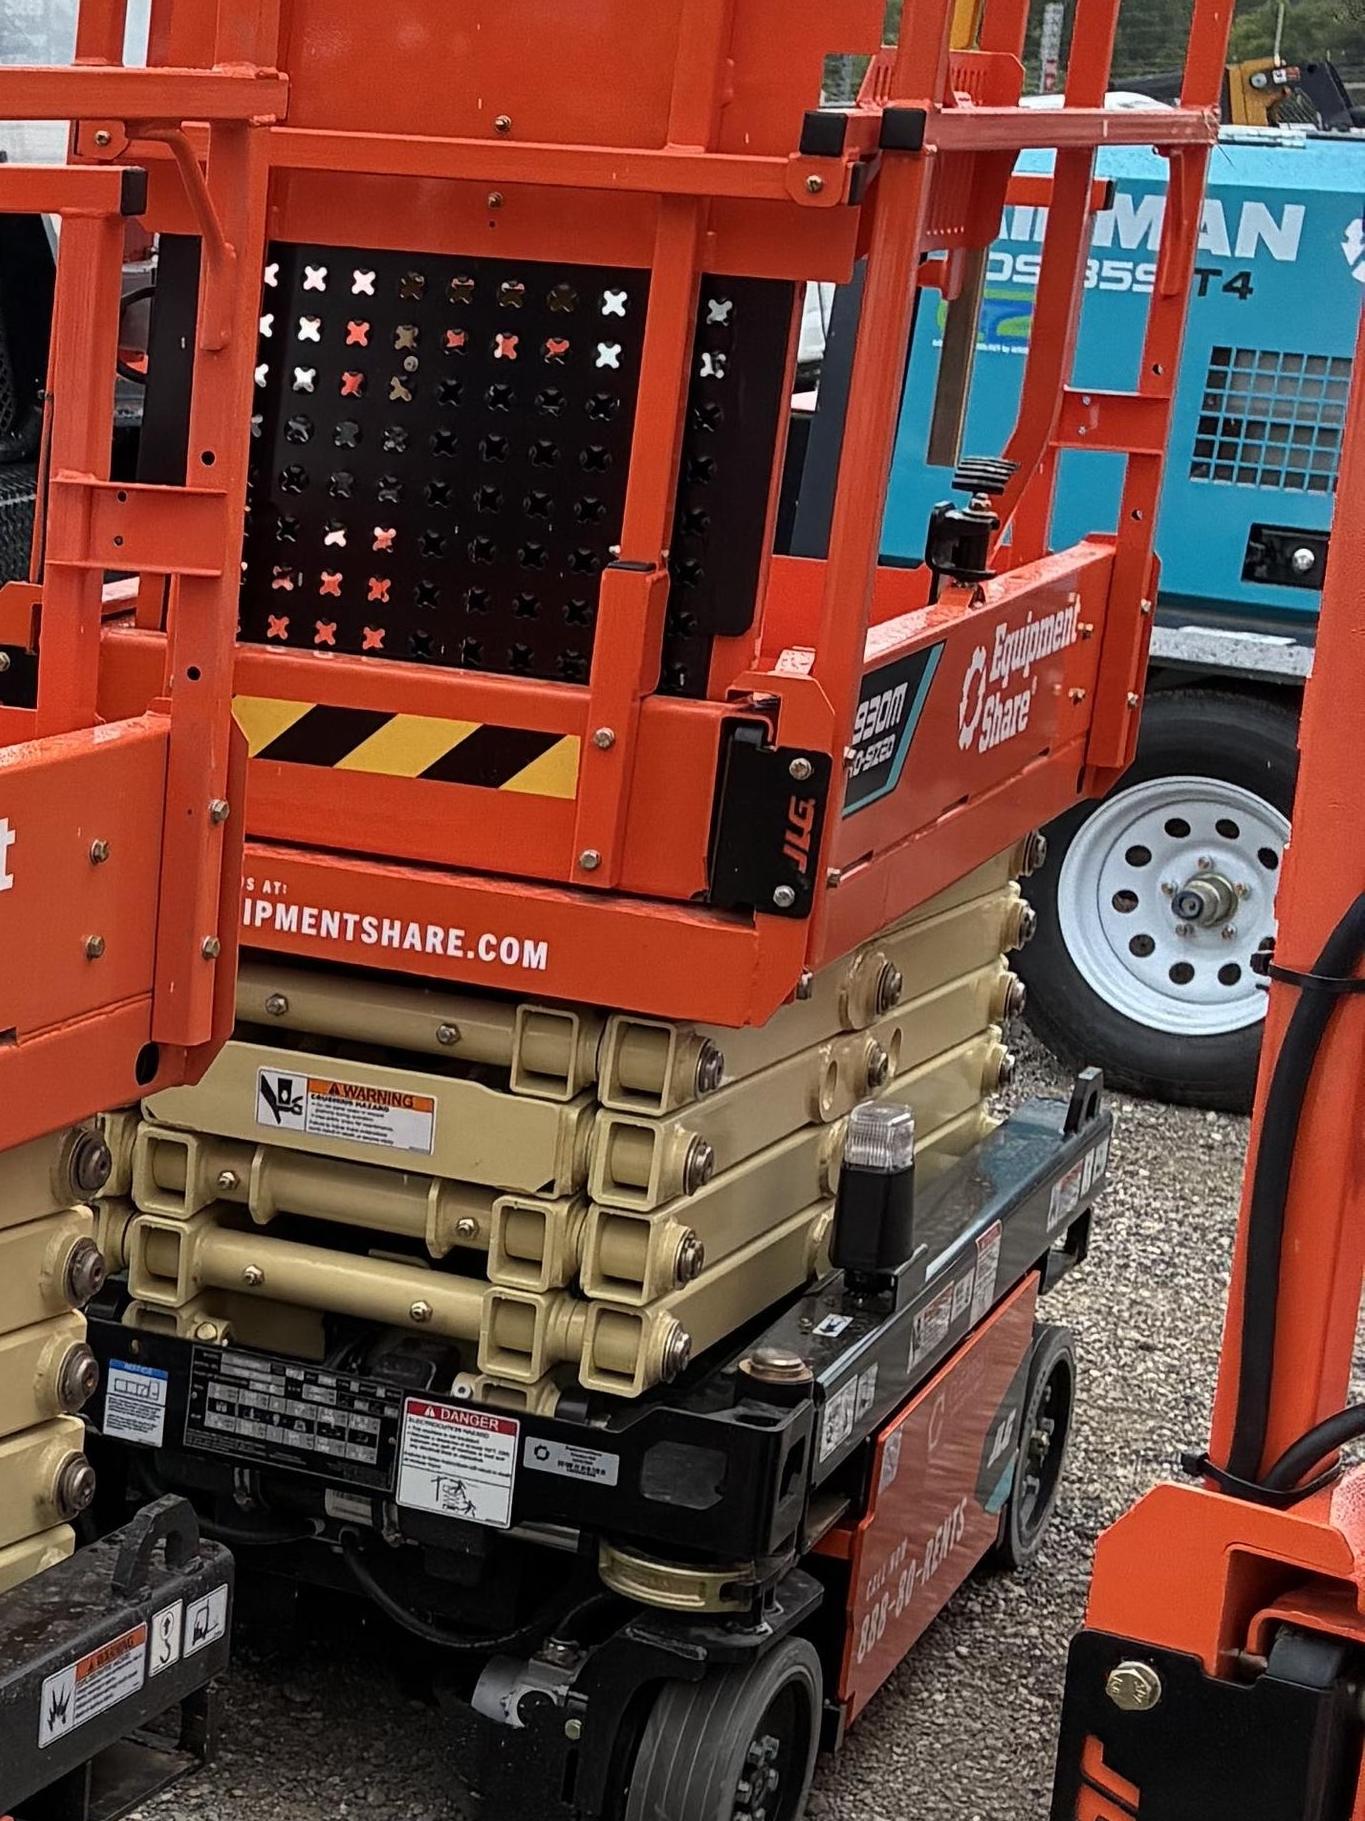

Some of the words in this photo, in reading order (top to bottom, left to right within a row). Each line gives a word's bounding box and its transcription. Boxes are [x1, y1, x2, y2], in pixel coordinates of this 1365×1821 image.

[989, 593, 1081, 689] Equipment
[851, 682, 908, 744] 930M
[783, 795, 816, 874] JLG
[263, 880, 288, 895] AT:
[243, 898, 548, 970] IPMENTSHARE.COM
[344, 1084, 414, 1108] WARNING
[440, 1408, 499, 1431] DANGER
